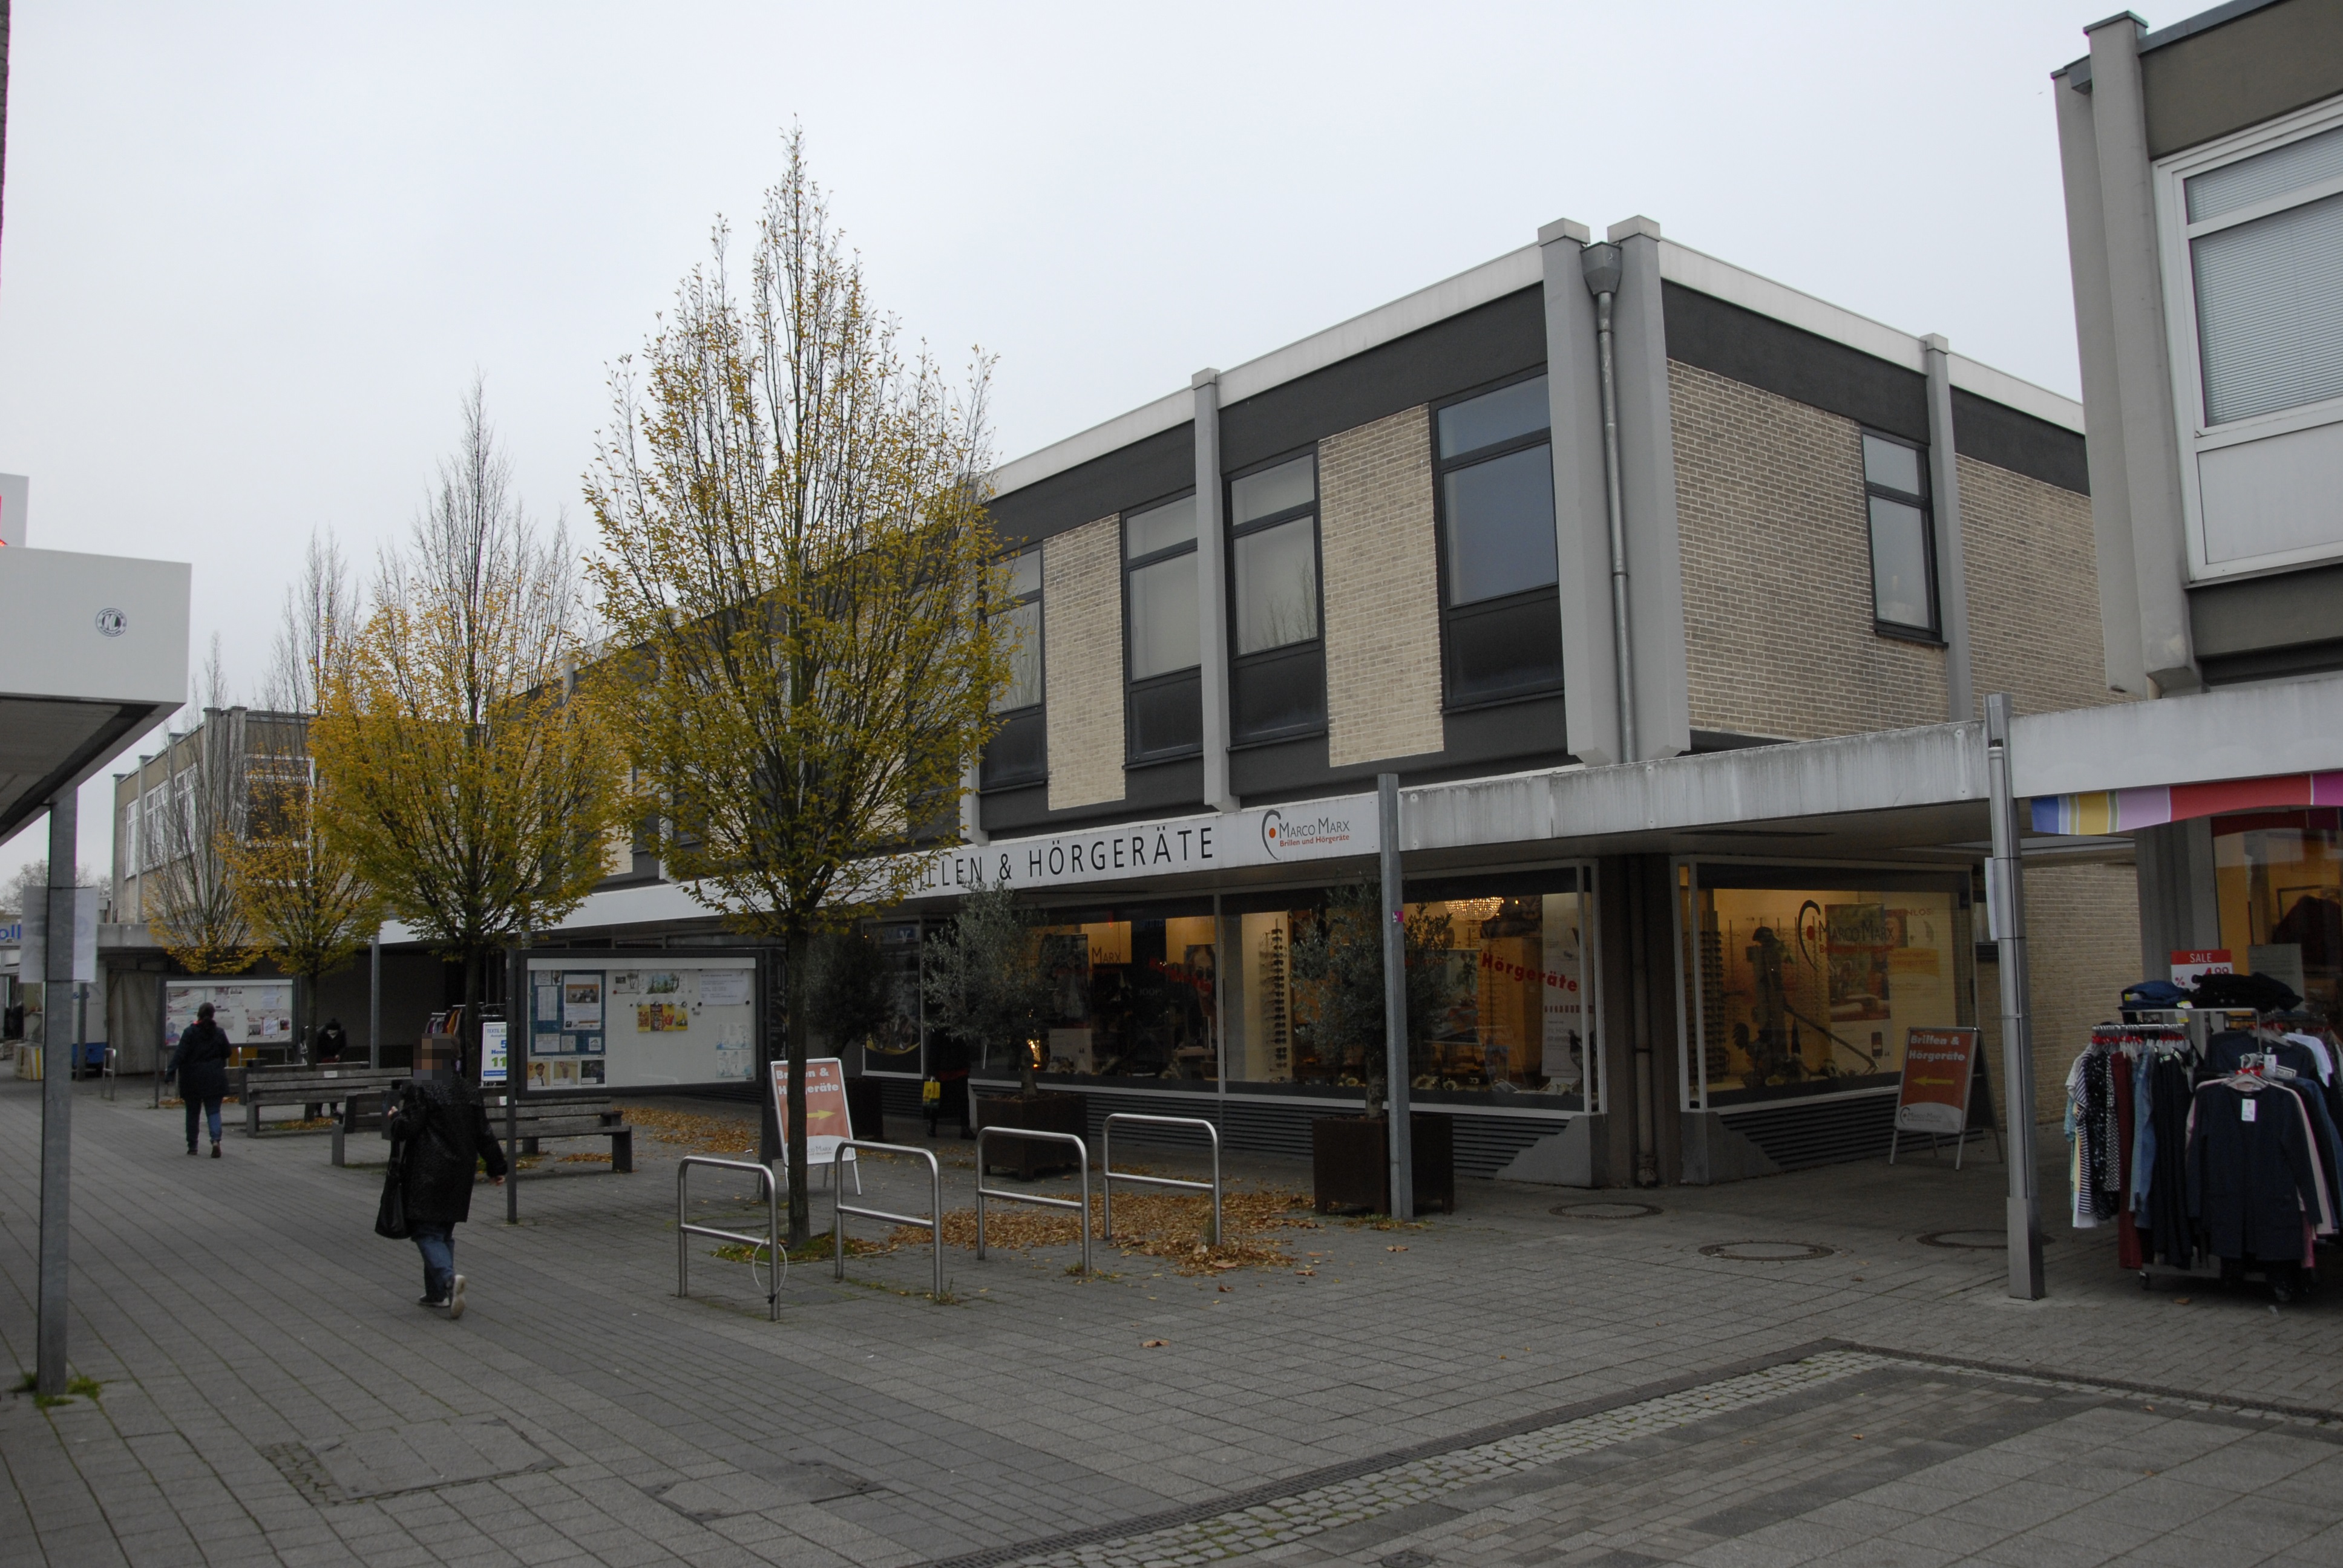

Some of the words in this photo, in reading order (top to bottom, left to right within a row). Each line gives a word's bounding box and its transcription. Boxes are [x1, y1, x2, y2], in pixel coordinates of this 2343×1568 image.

[1316, 834, 1350, 844] Hörgeräte
[999, 853, 1012, 880] &
[1029, 826, 1213, 878] HÖRGERÄTE
[2189, 953, 2212, 963] SALE
[1482, 952, 1578, 992] Hörgeräte
[1910, 1034, 1947, 1045] Brillen
[1950, 1036, 1960, 1045] &
[1909, 1050, 1965, 1062] Hörgeräte
[819, 1067, 830, 1077] &
[778, 1082, 839, 1096] Heräte
